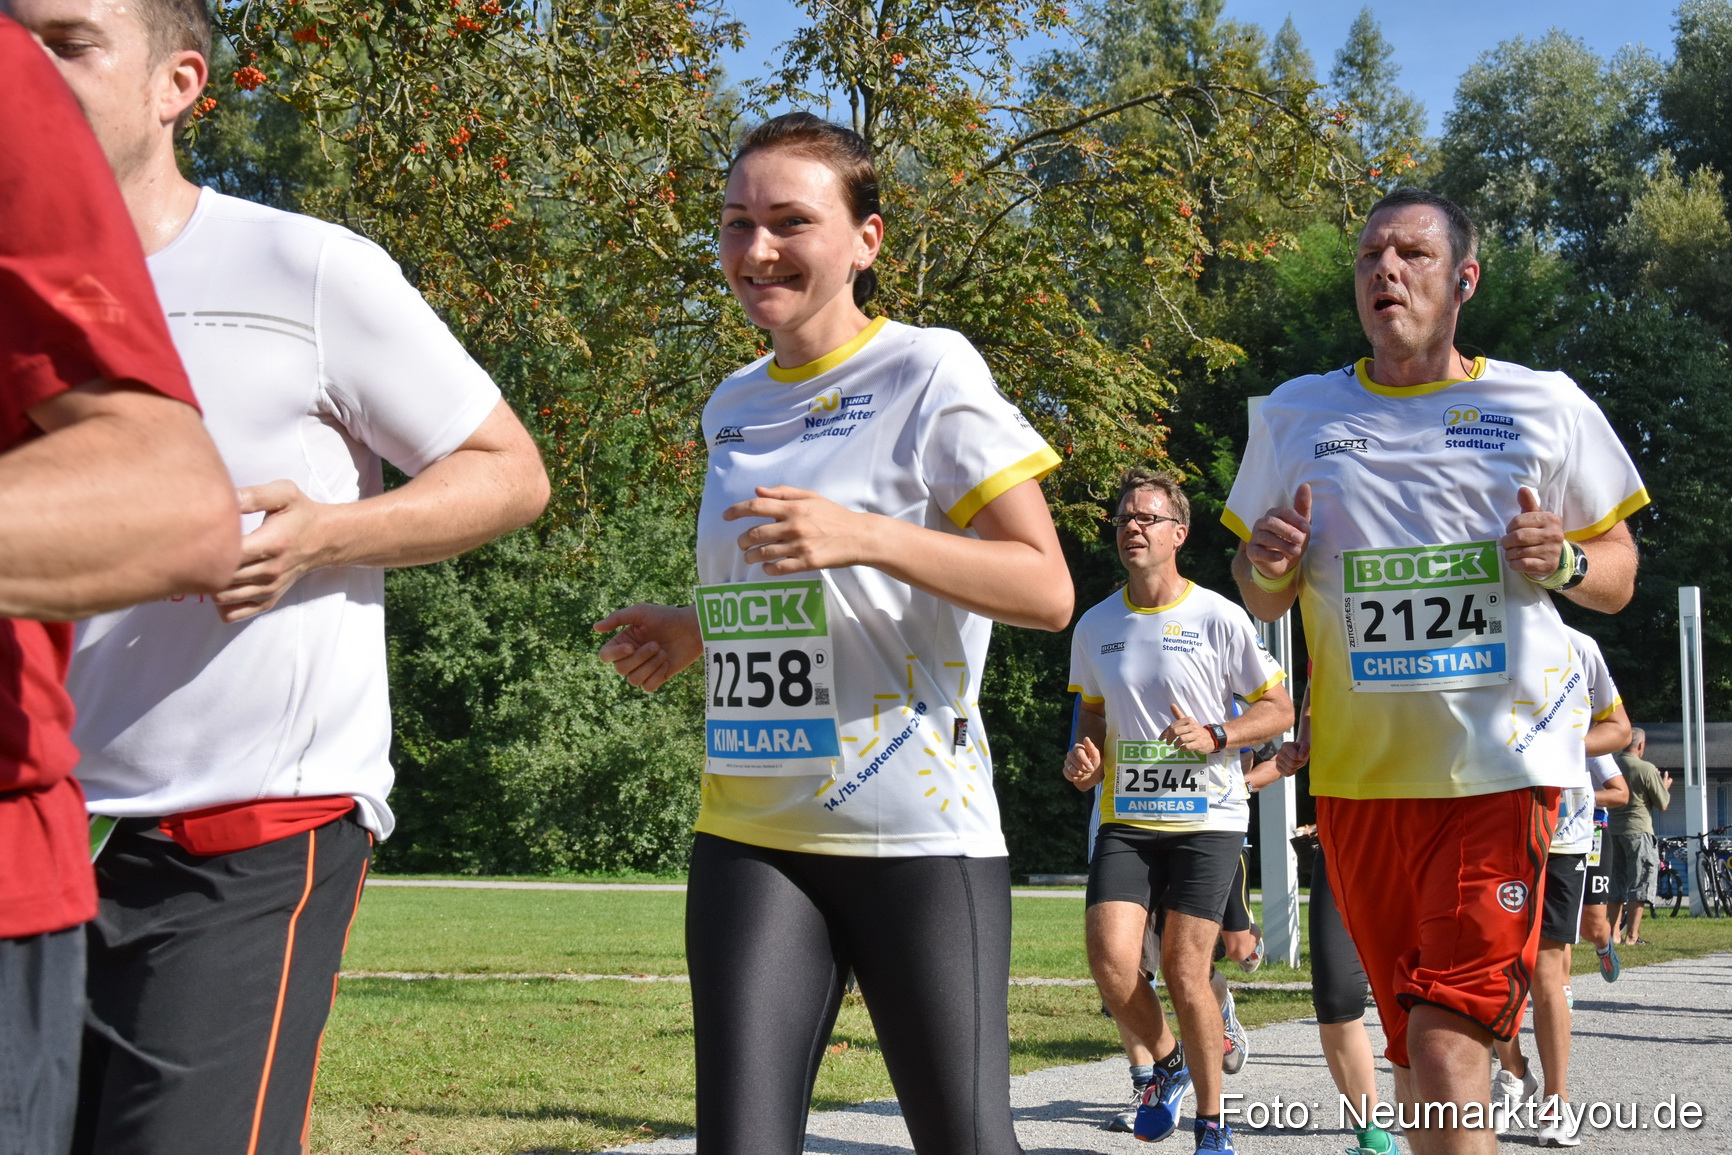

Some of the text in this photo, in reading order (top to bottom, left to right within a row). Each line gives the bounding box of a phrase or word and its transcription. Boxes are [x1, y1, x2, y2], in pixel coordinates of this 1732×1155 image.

[805, 409, 875, 428] Neumarkter
[1447, 409, 1511, 426] 20 JAHRE
[1445, 426, 1521, 441] Neumarkter
[1315, 438, 1368, 455] BOCK
[1445, 439, 1505, 451] Stadtlauf
[1353, 547, 1488, 587] BOCK
[704, 588, 814, 634] BOCK
[1361, 594, 1487, 642] 2124
[1164, 624, 1182, 636] 20
[1101, 642, 1125, 653] BOCK
[1162, 645, 1195, 654] Stadtlauf
[1163, 637, 1203, 647] Neumarkter
[1363, 650, 1492, 676] CHRISTIAN
[713, 649, 813, 708] 2258
[1515, 673, 1581, 754] 14./15. September 2019
[714, 728, 812, 753] KIM-LARA
[823, 782, 861, 812] 14./15.
[857, 725, 913, 783] September
[1125, 769, 1198, 792] 2544
[1128, 800, 1195, 811] ANDREAS
